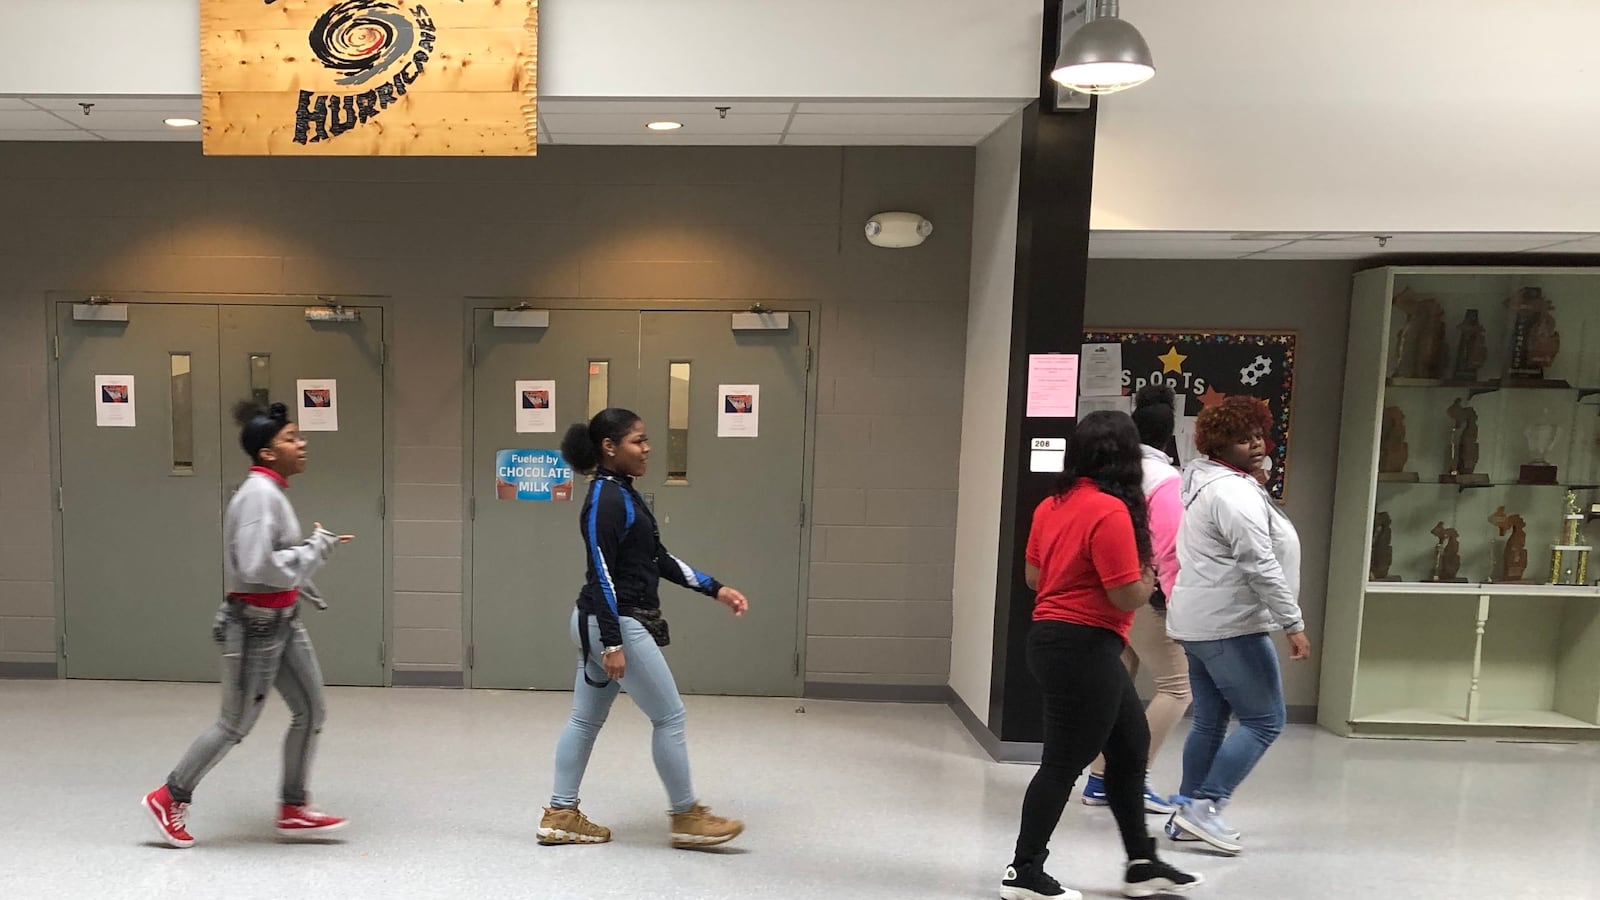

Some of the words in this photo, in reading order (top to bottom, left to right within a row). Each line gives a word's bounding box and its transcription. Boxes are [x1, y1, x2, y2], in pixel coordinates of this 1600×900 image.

[293, 4, 436, 145] HURRICANES
[1120, 369, 1205, 395] SPORTS
[1034, 440, 1050, 448] 208
[512, 454, 545, 464] Fueled
[546, 455, 559, 466] by
[500, 466, 571, 479] CHOCOLATE
[519, 481, 550, 493] MILK
